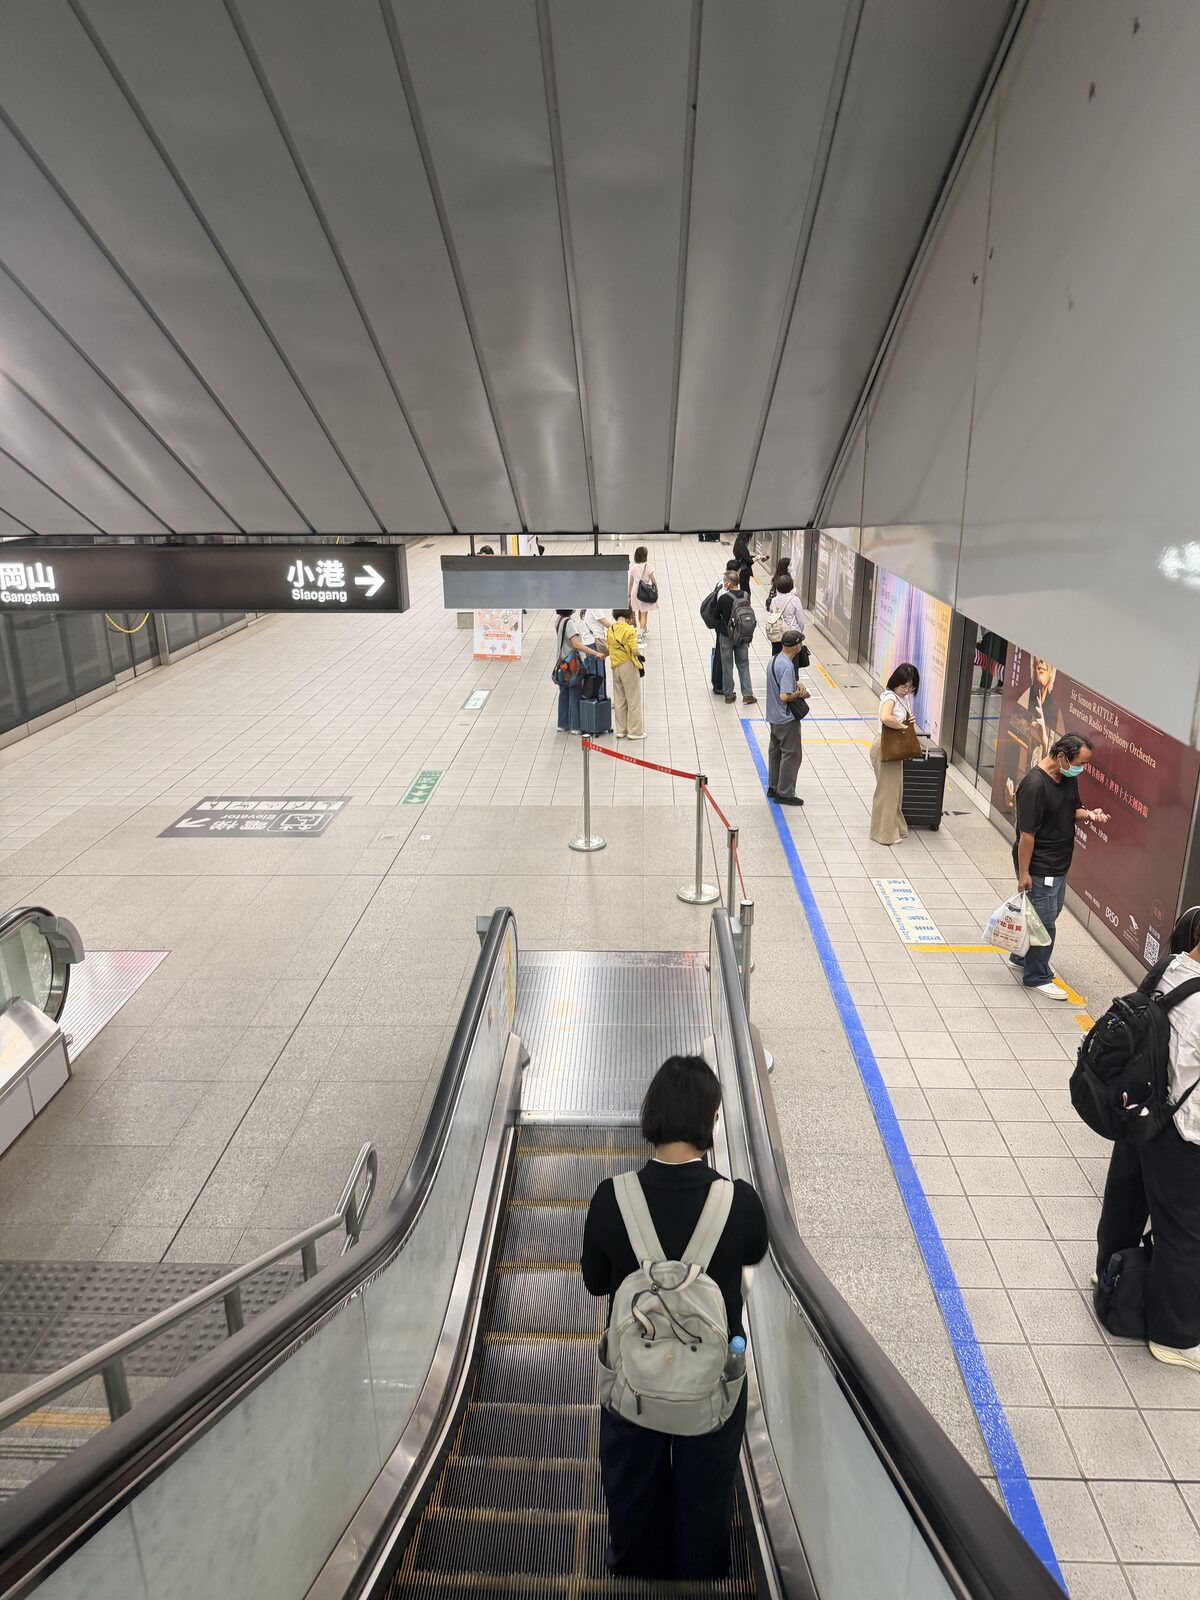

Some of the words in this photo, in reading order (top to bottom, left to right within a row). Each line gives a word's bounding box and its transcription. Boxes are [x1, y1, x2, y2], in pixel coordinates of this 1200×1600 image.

[0, 562, 56, 590] 岡山
[287, 560, 346, 588] 小港
[0, 591, 60, 605] Gangshan
[291, 588, 348, 603] Siaogang
[1070, 689, 1078, 701] Sir
[1078, 693, 1092, 709] Simon
[1092, 702, 1115, 724] RATTLE
[1114, 716, 1120, 728] &
[1069, 702, 1088, 723] Bavarian
[1088, 716, 1103, 732] Radio
[1102, 725, 1129, 752] Symphony
[1129, 742, 1157, 768] Orchestra
